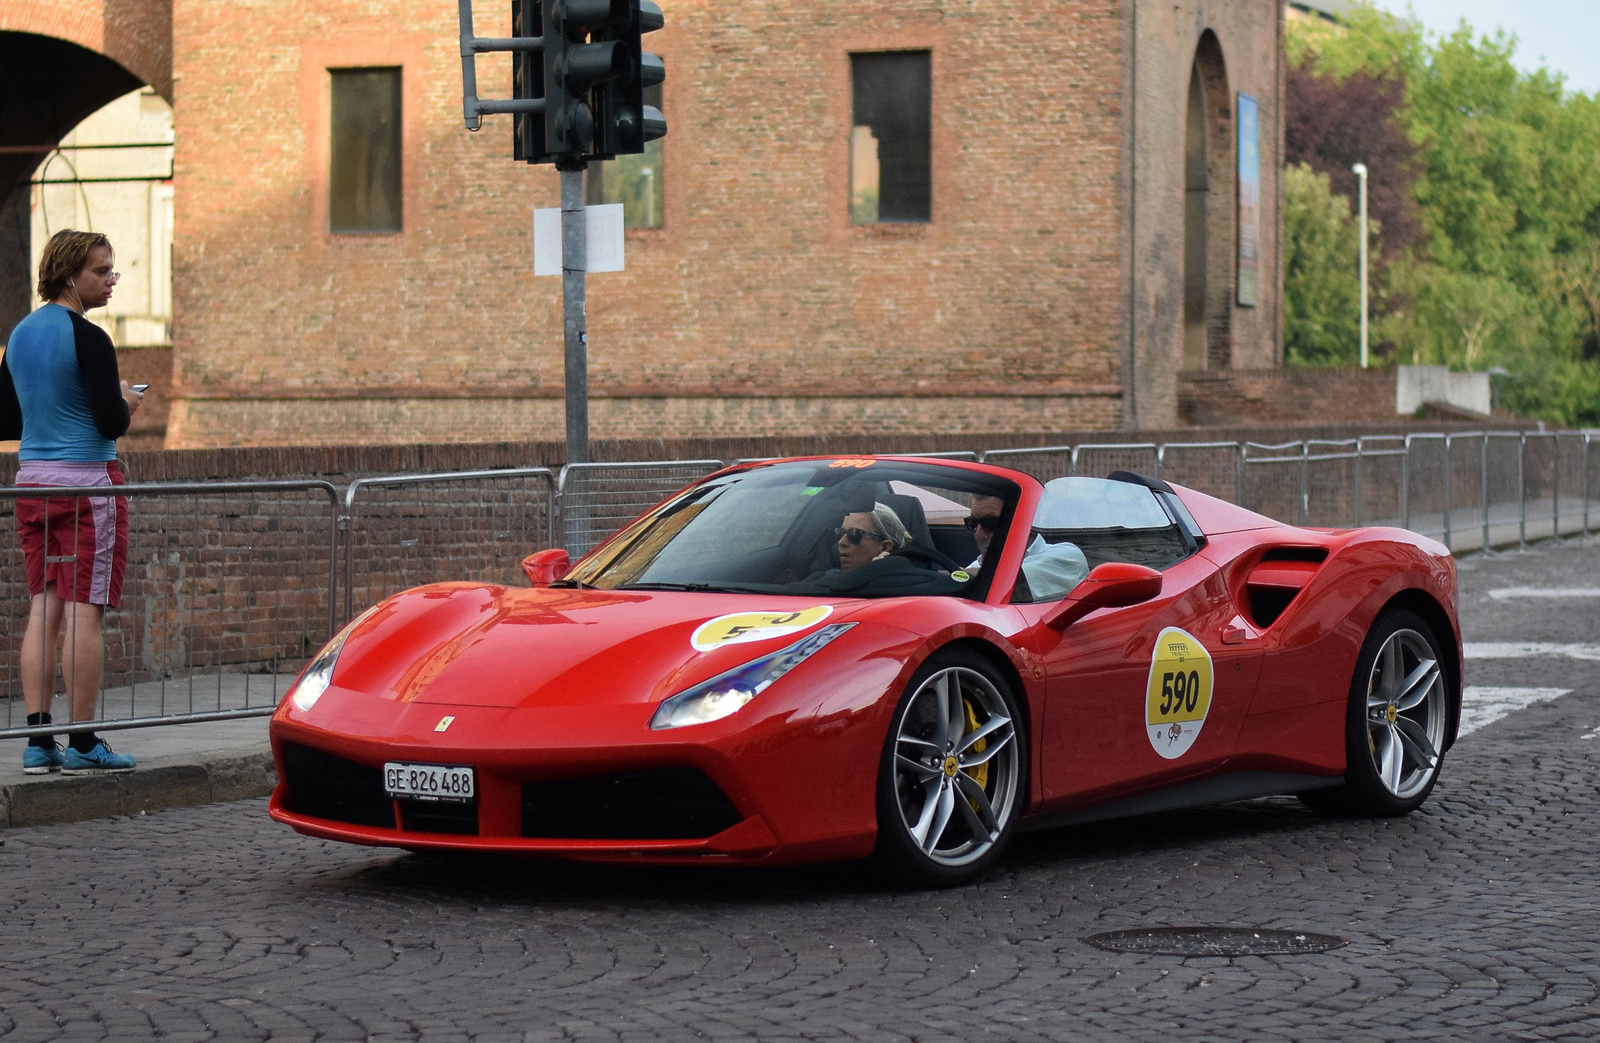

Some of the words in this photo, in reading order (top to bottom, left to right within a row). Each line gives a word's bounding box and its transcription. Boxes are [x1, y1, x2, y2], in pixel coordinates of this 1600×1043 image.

[828, 459, 876, 468] 590
[1168, 643, 1189, 652] Ferrari
[1160, 669, 1200, 715] 590
